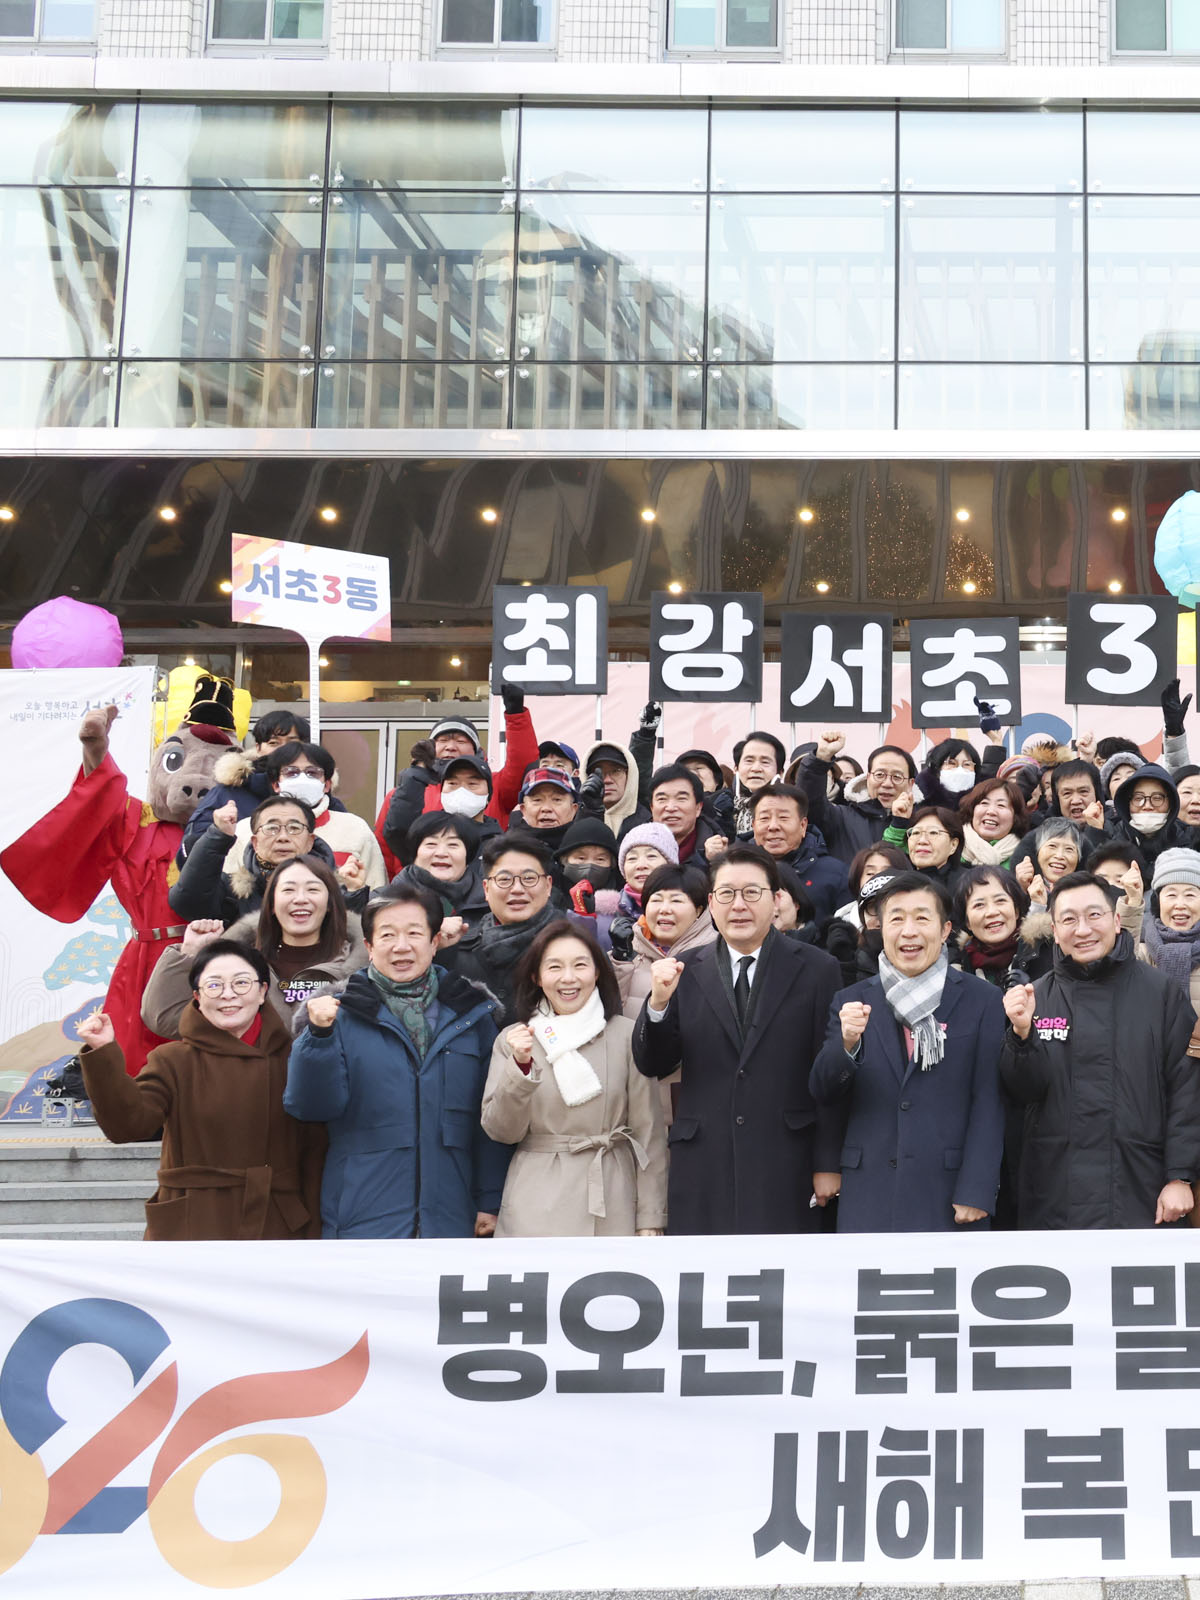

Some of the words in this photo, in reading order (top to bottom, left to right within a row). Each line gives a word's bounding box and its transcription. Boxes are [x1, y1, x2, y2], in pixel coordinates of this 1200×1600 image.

[245, 563, 379, 612] 서초3동
[503, 594, 597, 684] 최
[659, 602, 753, 691] 강
[791, 623, 882, 712] 서
[921, 628, 1011, 717] 초
[1087, 604, 1157, 694] 3
[289, 981, 330, 989] 서초구의
[438, 1269, 816, 1401] 병오년,
[854, 1265, 1073, 1394] 붉은
[753, 1427, 984, 1561] 새해
[1022, 1428, 1127, 1559] 복
